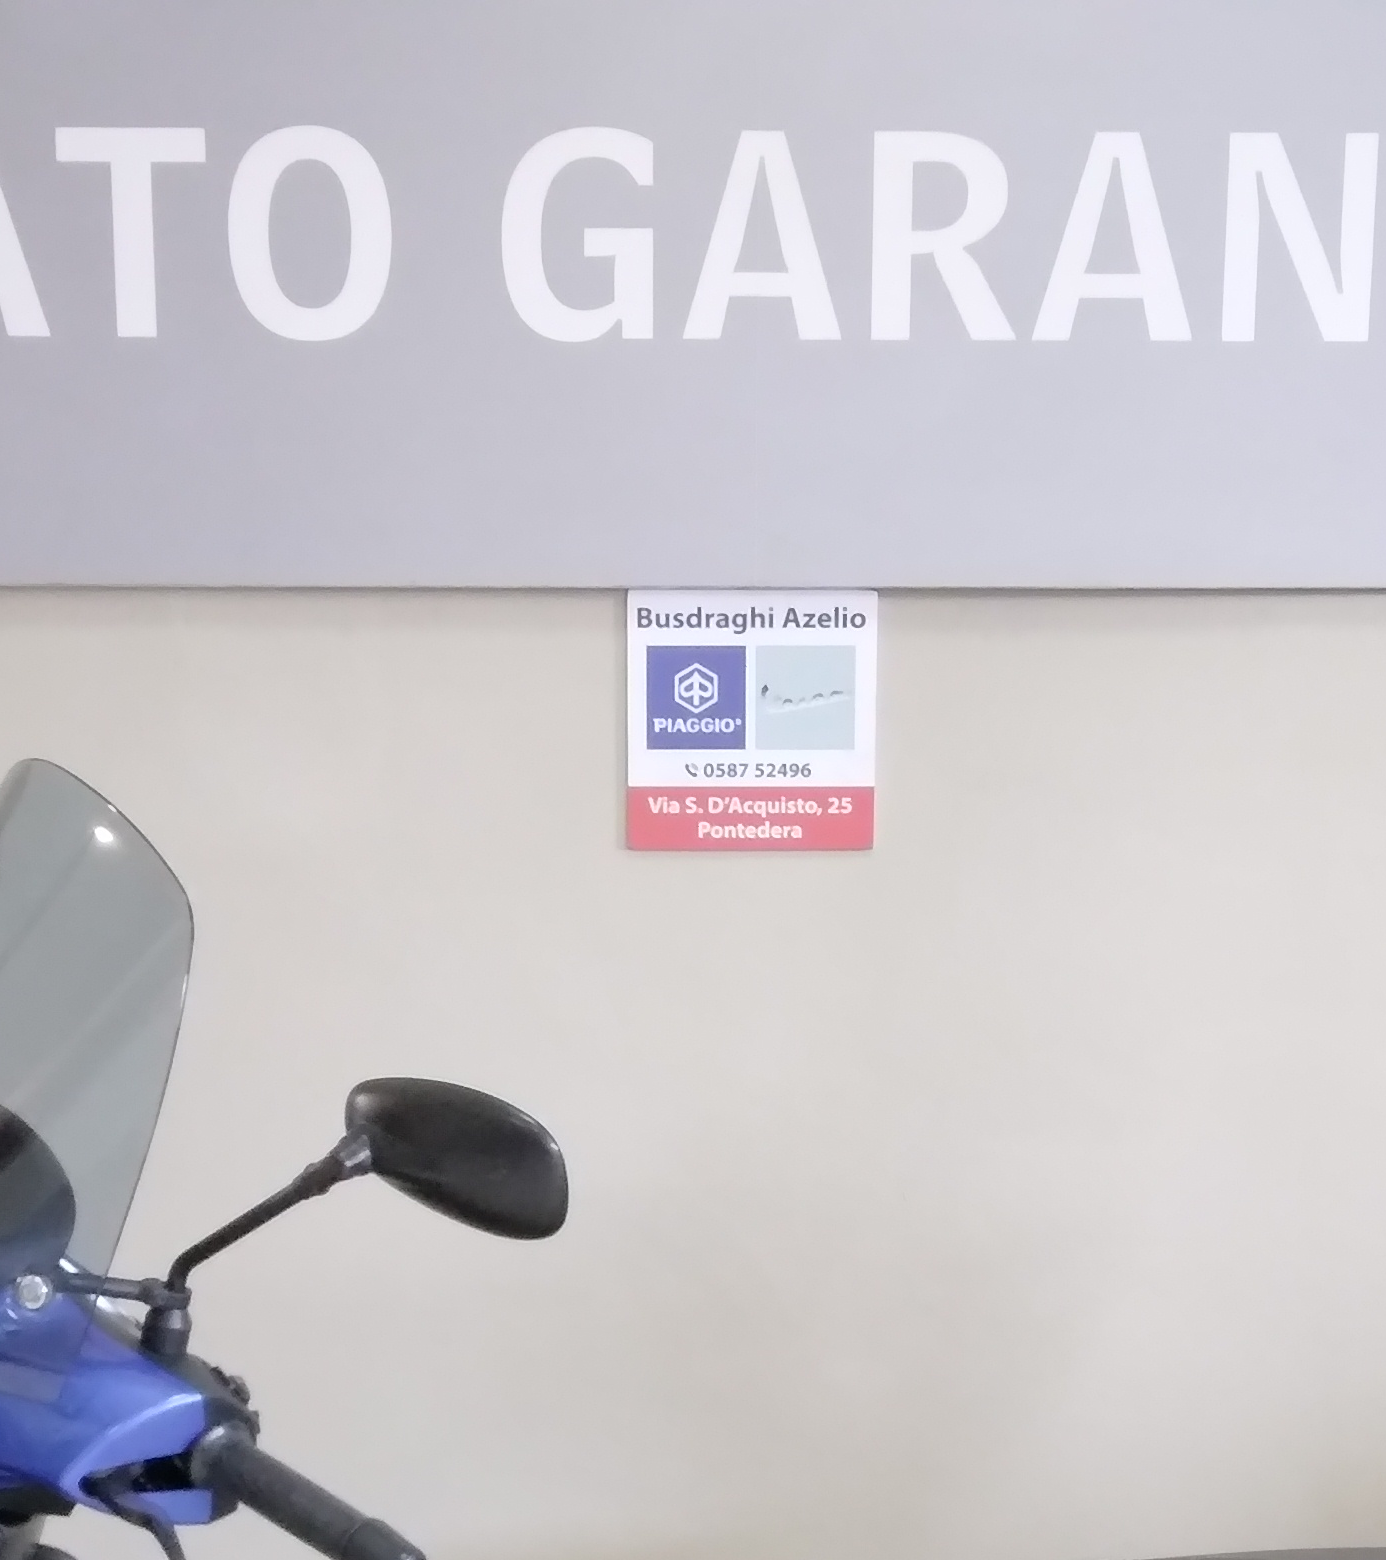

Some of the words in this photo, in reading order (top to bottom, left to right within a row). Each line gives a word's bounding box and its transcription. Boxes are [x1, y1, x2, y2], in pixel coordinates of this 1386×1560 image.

[636, 606, 775, 635] Busdraghi
[782, 606, 867, 629] Azelio
[703, 763, 749, 778] 0587
[754, 763, 812, 778] 52496
[647, 796, 680, 814] Via
[685, 796, 704, 814] S.
[827, 797, 853, 814] 25
[698, 821, 803, 839] Pontedera
